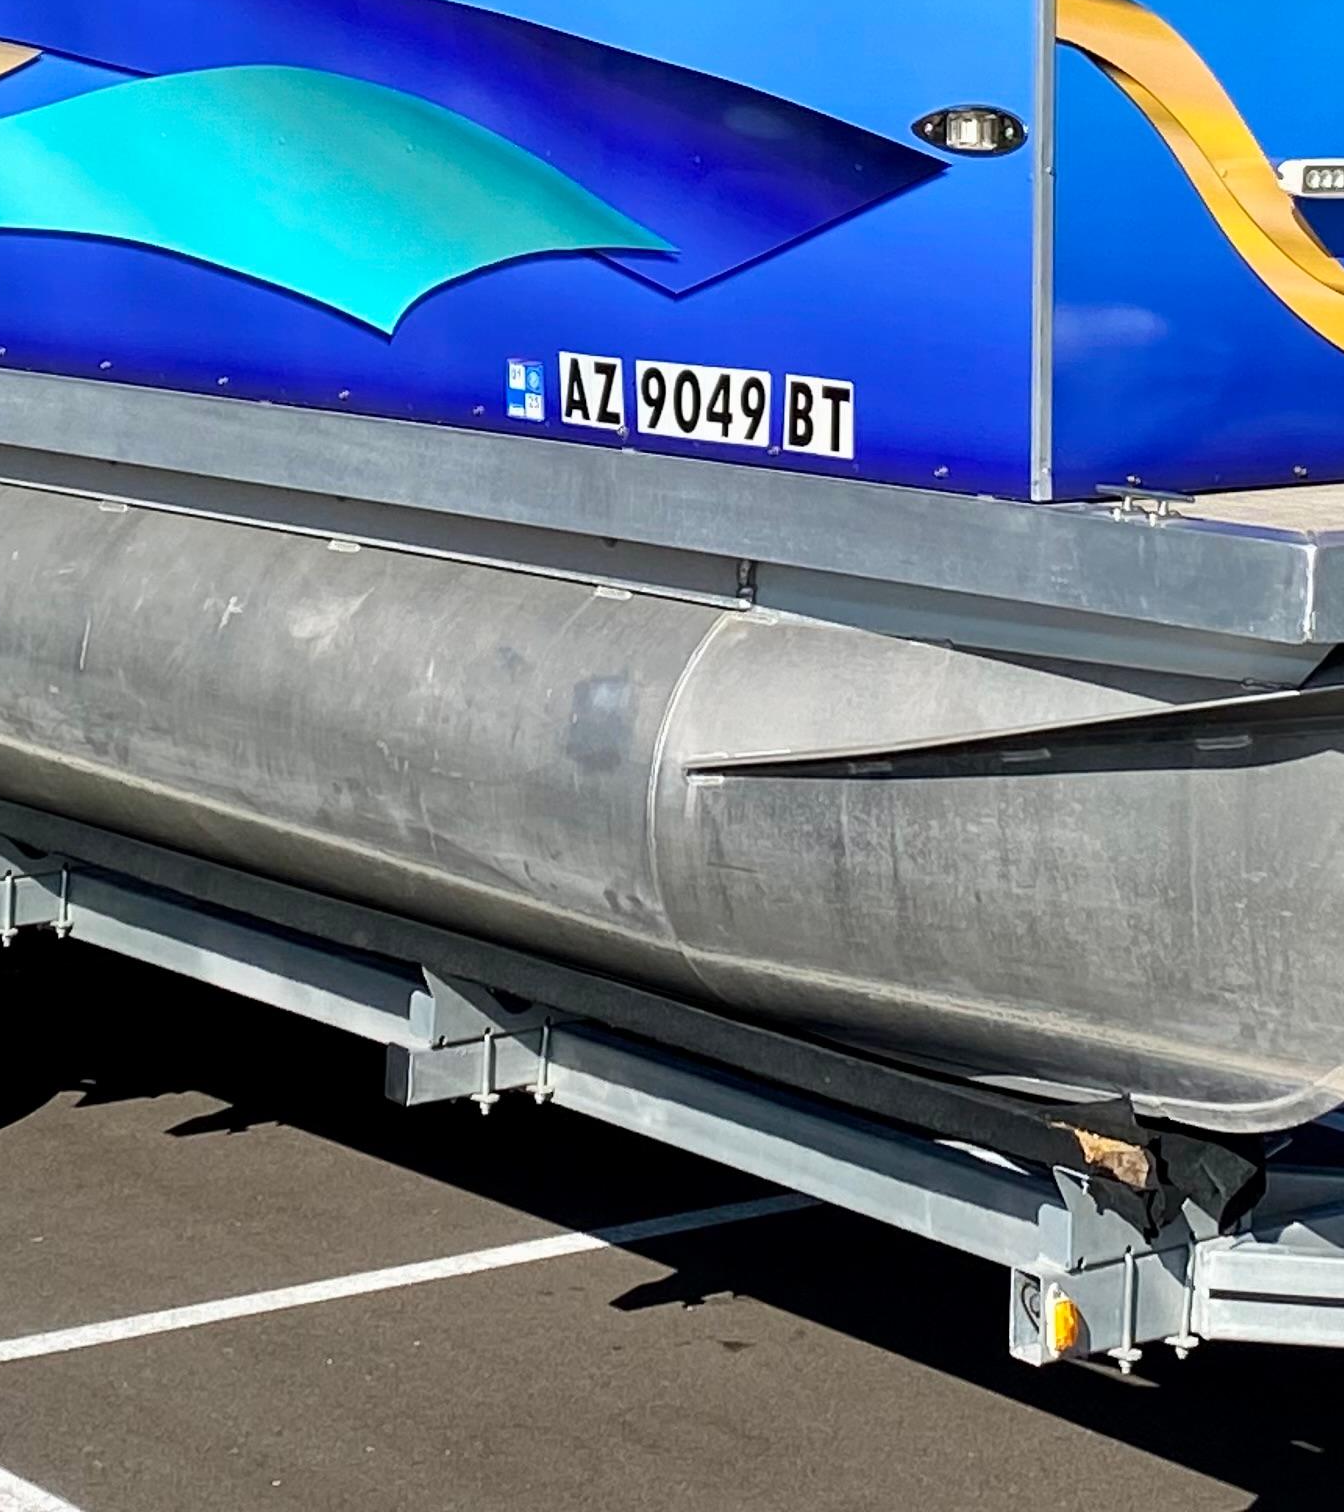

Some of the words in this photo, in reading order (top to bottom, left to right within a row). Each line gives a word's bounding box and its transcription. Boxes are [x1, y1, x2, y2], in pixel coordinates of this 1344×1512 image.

[564, 357, 622, 425] AZ
[640, 366, 767, 441] 9049
[788, 380, 852, 453] BT
